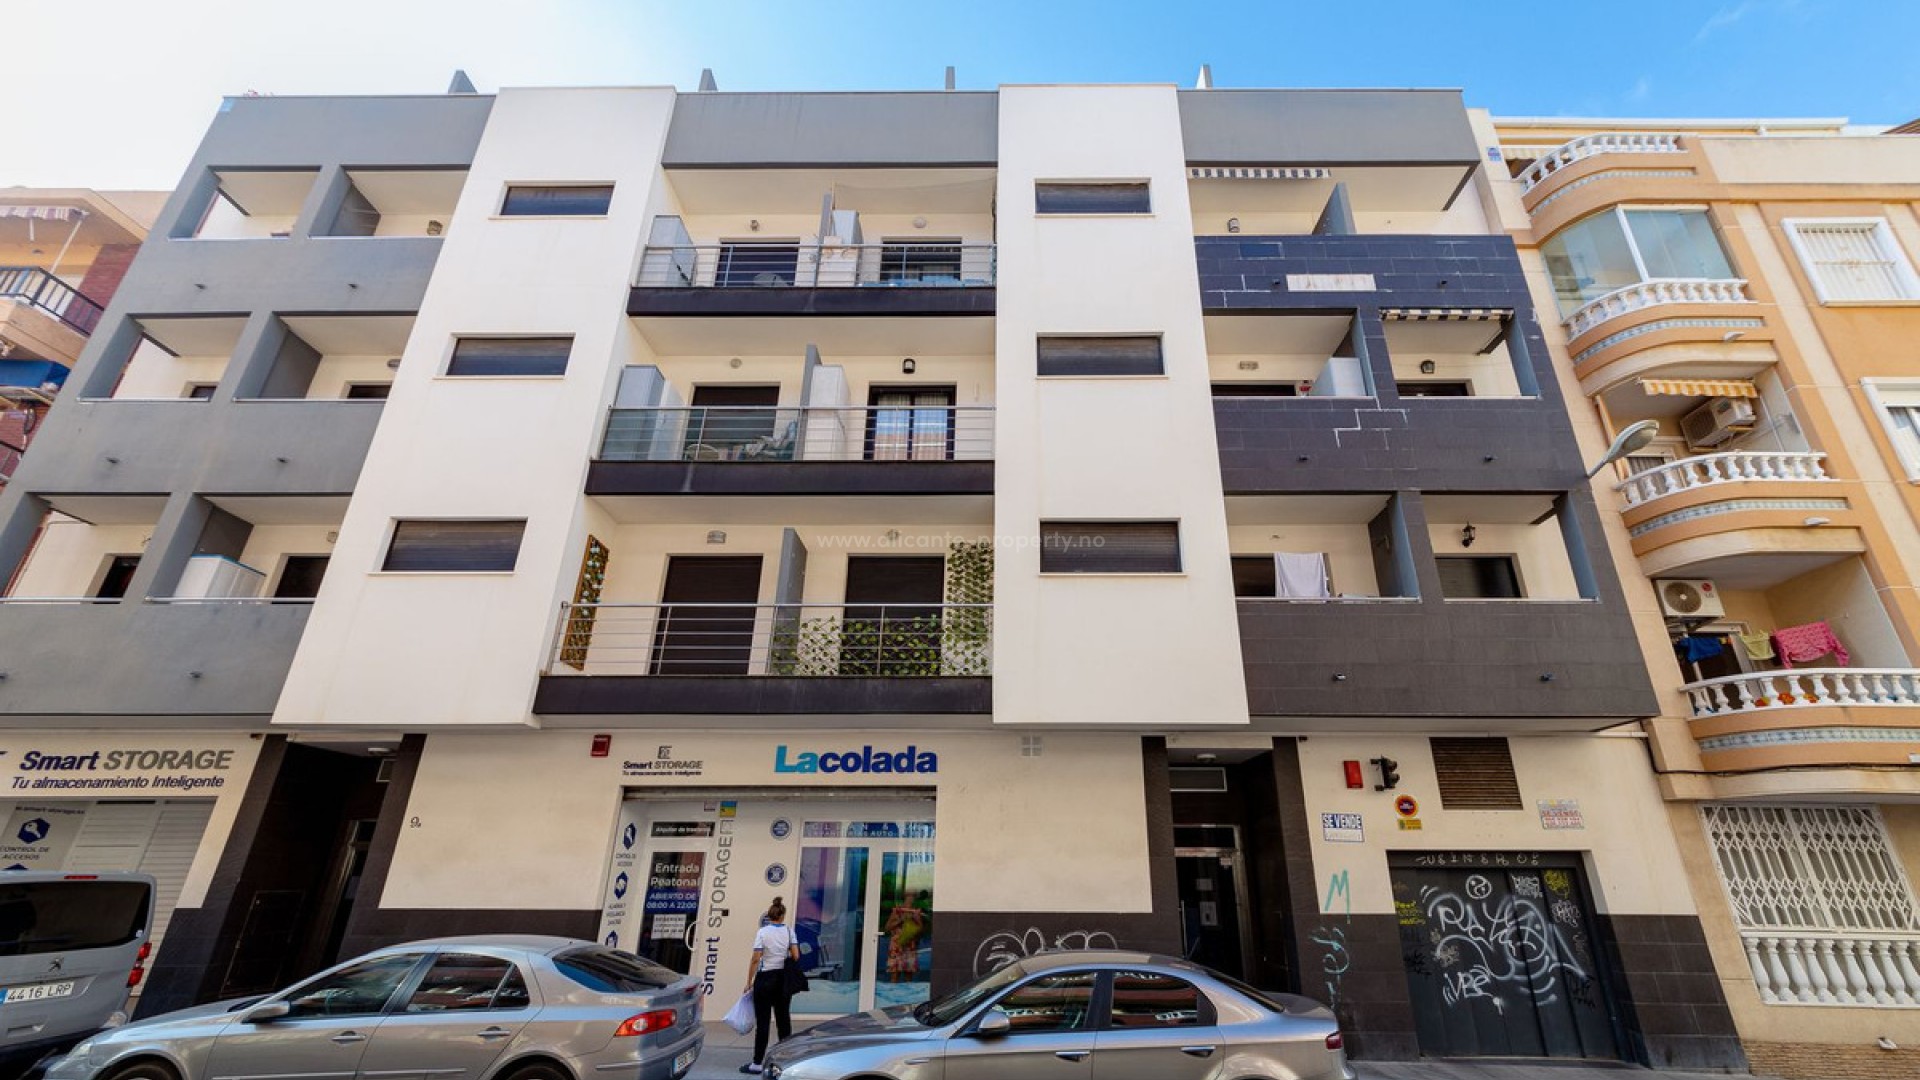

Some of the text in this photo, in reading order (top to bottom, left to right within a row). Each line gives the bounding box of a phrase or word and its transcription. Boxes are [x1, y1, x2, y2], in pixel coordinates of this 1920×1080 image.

[19, 750, 235, 770] Smart STORAGE
[623, 760, 703, 769] Smart STORAGE
[774, 745, 938, 773] Lacolada
[12, 775, 225, 790] Tu almacenamiento Inteligente
[1334, 814, 1361, 828] VENDE
[655, 862, 699, 873] Entrada
[651, 877, 701, 887] Peatonal
[701, 836, 733, 995] Smart STORAGE
[7, 983, 71, 1000] 4416 LRP
